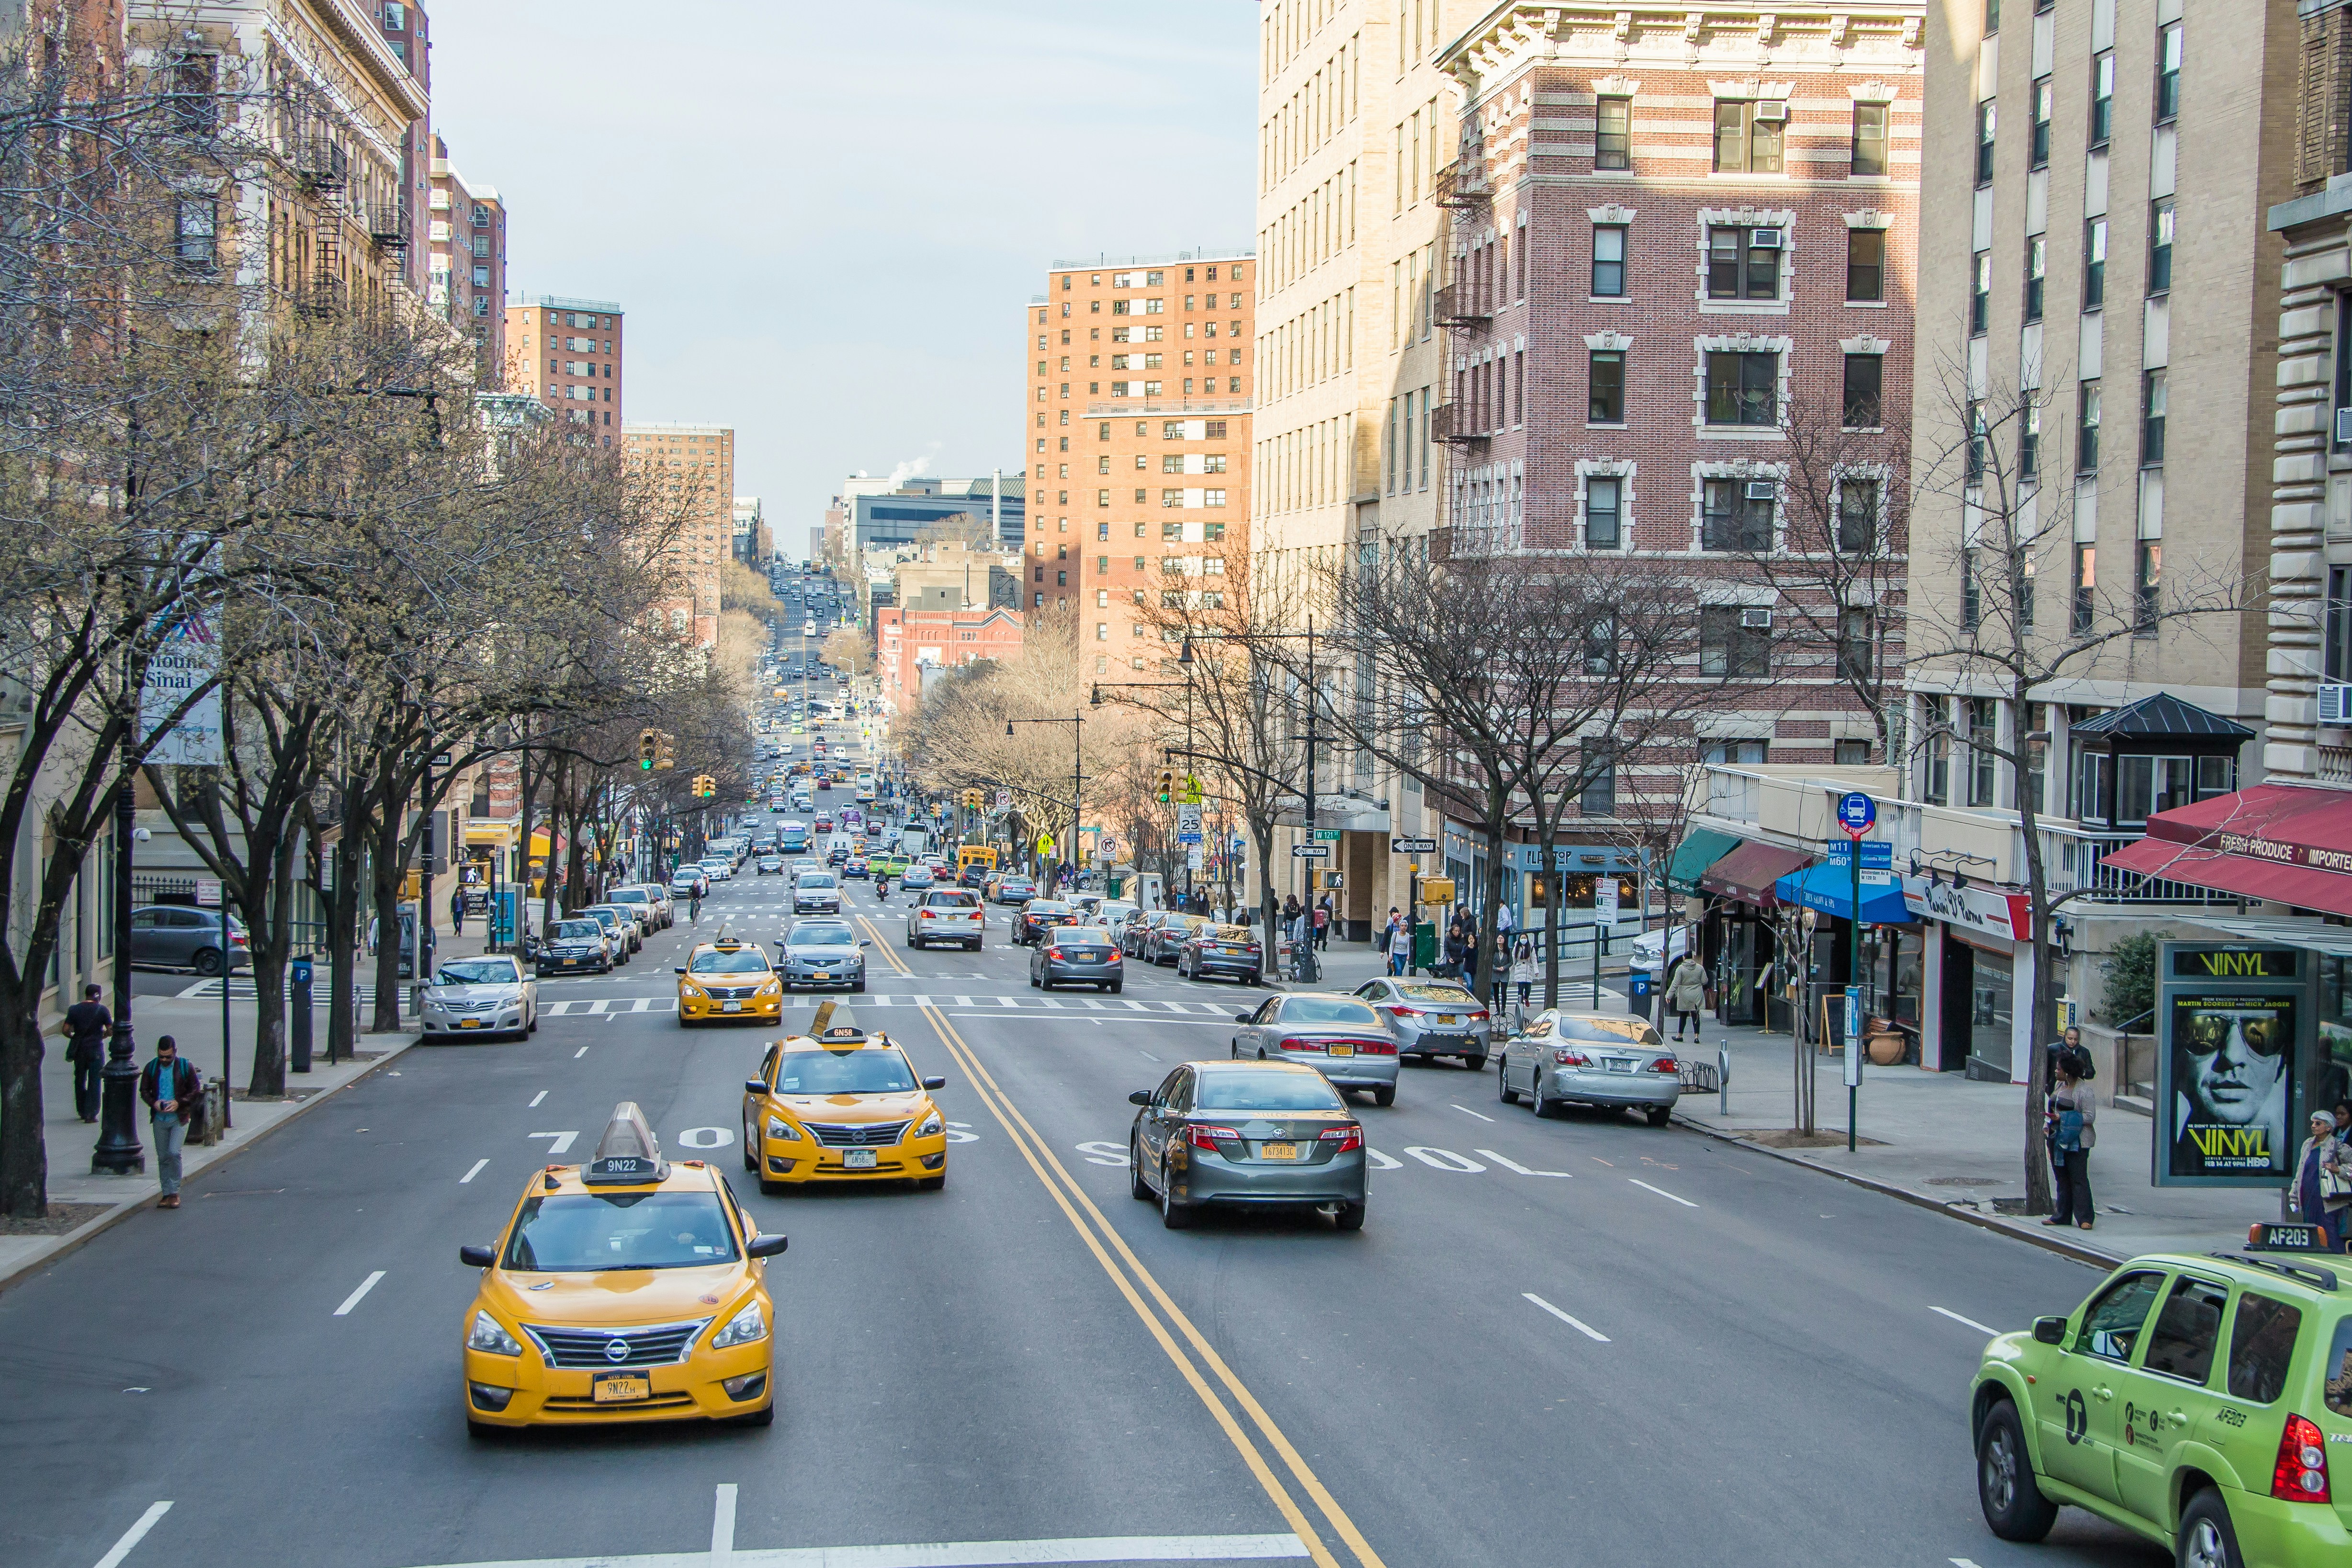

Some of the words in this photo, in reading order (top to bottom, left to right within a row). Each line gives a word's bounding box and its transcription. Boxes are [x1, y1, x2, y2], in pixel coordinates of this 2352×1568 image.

[146, 671, 192, 688] Sinai
[1182, 820, 1199, 830] 25
[1848, 823, 1871, 834] STANDING
[1830, 842, 1847, 851] M11
[2221, 835, 2248, 852] FRESH
[2250, 839, 2293, 860] PRODUCE
[2309, 849, 2352, 871] IMPORTE
[1925, 886, 1949, 915] Panini
[2199, 953, 2268, 975] VINYL
[300, 970, 307, 980] P
[1638, 982, 1645, 993] P
[2188, 1128, 2270, 1155] VINYL
[1265, 1147, 1293, 1156] T673413C
[608, 1160, 636, 1172] 9N22
[2246, 1157, 2270, 1167] HBO
[2269, 1228, 2309, 1246] AF203
[2215, 1408, 2247, 1428] AF203
